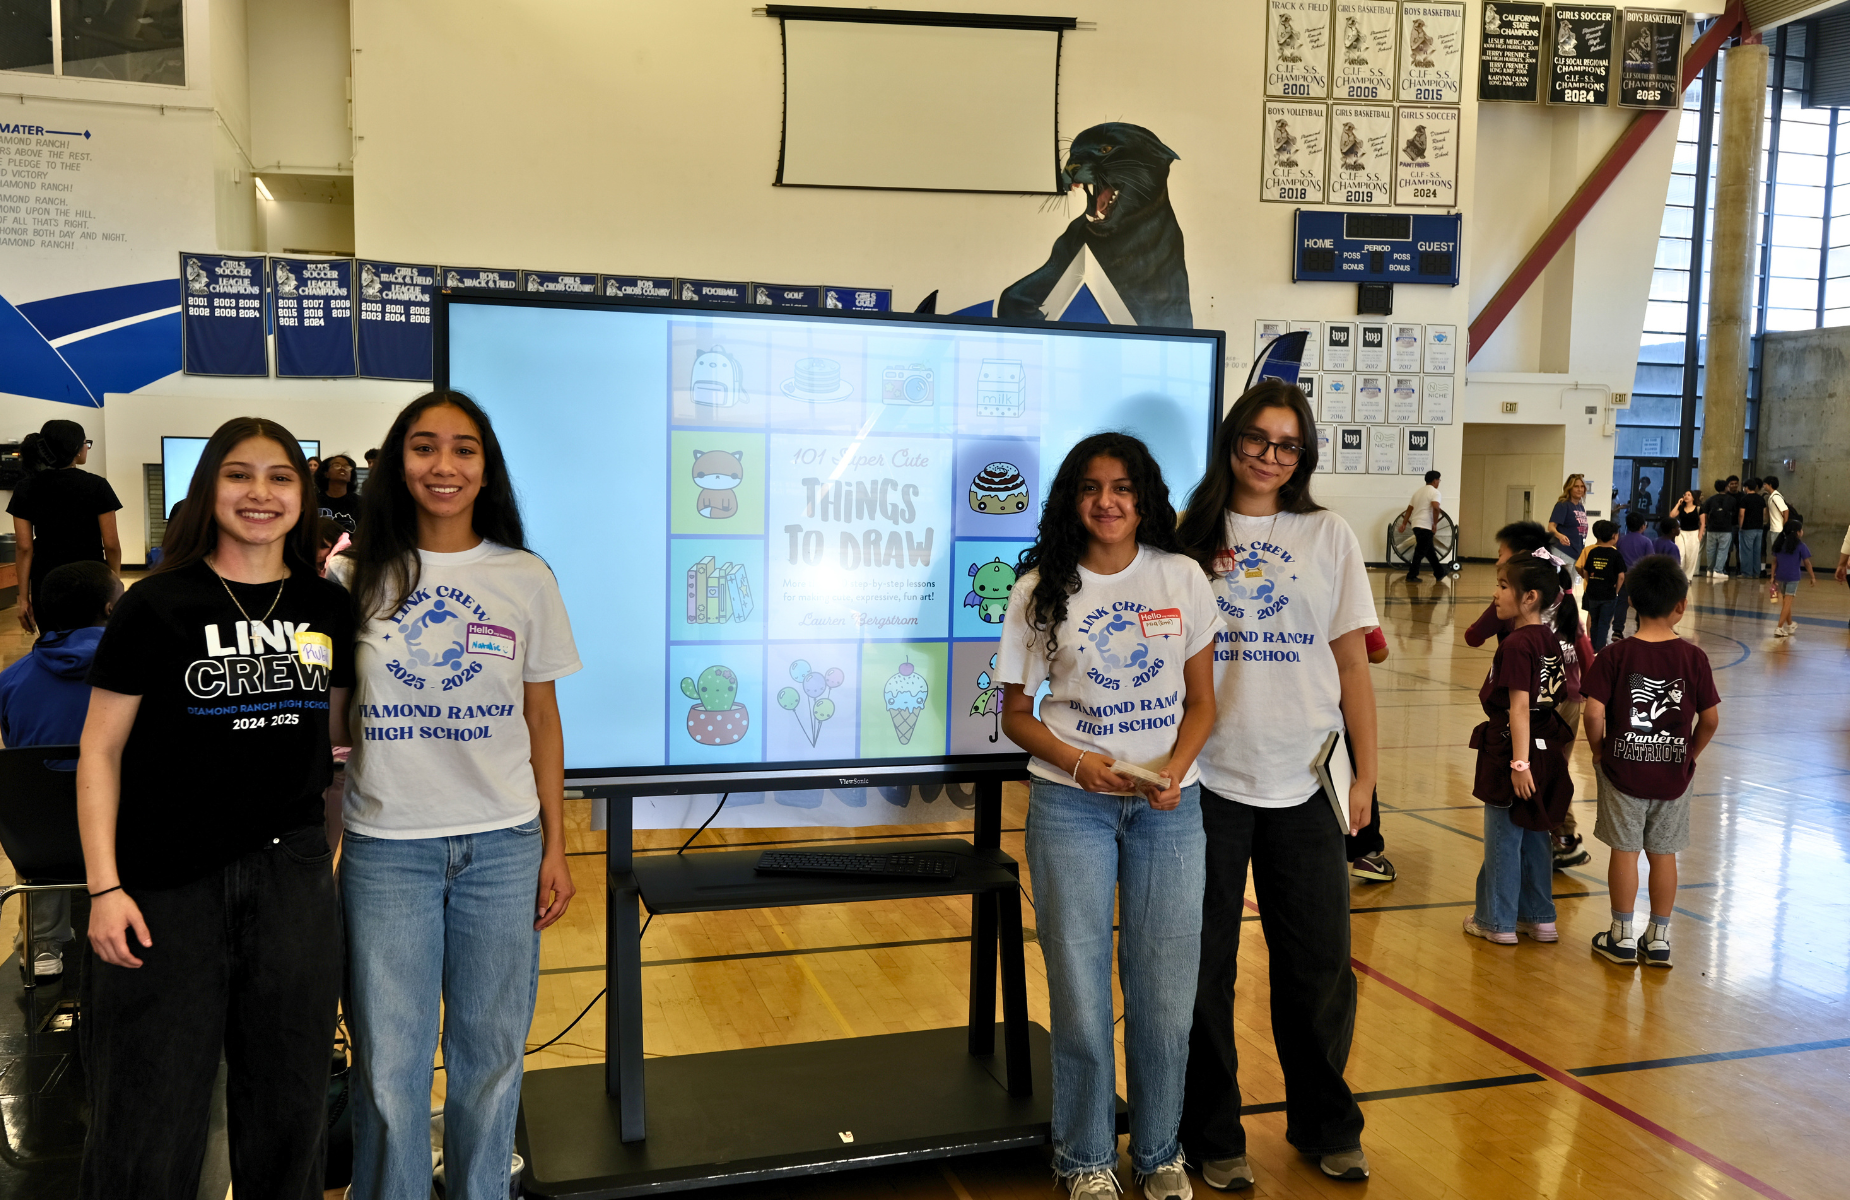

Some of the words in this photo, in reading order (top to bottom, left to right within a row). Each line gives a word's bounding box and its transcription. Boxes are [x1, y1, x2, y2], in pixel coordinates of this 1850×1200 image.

[1272, 1, 1296, 10] TRACK
[1308, 3, 1328, 12] FIELD
[1338, 4, 1356, 12] GIRLS
[1358, 6, 1394, 14] BASKETBALL
[1404, 8, 1420, 16] BOYS
[1423, 8, 1461, 18] BASKETBALL
[1502, 14, 1540, 22] CALIFORNIA
[1556, 10, 1579, 20] GIRLS
[1580, 12, 1612, 21] SOCCER
[1627, 12, 1643, 22] BOYS
[1644, 14, 1682, 24] BASKETBALL
[1501, 28, 1539, 36] CHAMPIONS
[1556, 65, 1606, 76] CHAMPIONS
[1269, 73, 1326, 88] CHAMPIONS
[1336, 76, 1392, 90] CHAMPIONS
[1402, 78, 1458, 93] CHAMPIONS
[1623, 80, 1675, 92] CHAMPIONS
[1283, 83, 1310, 96] 2001
[1348, 86, 1378, 98] 2006
[1556, 81, 1604, 92] CHAMPIONS
[1416, 88, 1442, 100] 2015
[1564, 90, 1594, 102] 2024
[1636, 90, 1661, 100] 2025
[1268, 107, 1284, 116] BOYS
[1287, 108, 1324, 117] VOLLEYBALL
[1354, 110, 1390, 118] BASKETBALL
[1401, 111, 1424, 119] GIRLS
[1426, 112, 1456, 120] SOCCER
[0, 123, 44, 136] MATER
[36, 139, 70, 149] RANCH!
[14, 148, 43, 158] ABOVE
[48, 150, 64, 159] THE
[8, 158, 41, 168] PLEDGE
[46, 161, 56, 170] TO
[60, 162, 81, 171] THEE
[12, 169, 48, 180] VICTORY
[41, 182, 73, 192] RANCH!
[1266, 178, 1322, 192] CHAMPIONS
[1332, 180, 1388, 194] CHAMPIONS
[1399, 178, 1452, 190] CHAMPIONS
[1280, 187, 1306, 200] 2018
[1346, 190, 1373, 202] 2019
[1414, 188, 1437, 198] 2024
[26, 207, 50, 216] UPON
[55, 208, 70, 217] THE
[12, 216, 28, 226] ALL
[0, 227, 28, 236] HONOR
[33, 228, 55, 238] BOTH
[59, 230, 75, 239] DAY
[80, 232, 97, 240] AND
[41, 240, 74, 250] RANCH!
[1304, 239, 1334, 248] HOME
[1418, 242, 1454, 252] GUEST
[221, 260, 246, 268] GIRLS
[215, 267, 252, 276] SOCCER
[303, 270, 338, 278] SOCCER
[395, 267, 418, 276] GIRLS
[219, 278, 250, 286] LEAGUE
[308, 280, 338, 288] LEAGUE
[210, 284, 260, 294] CHAMPIONS
[299, 287, 348, 296] CHAMPIONS
[392, 284, 422, 294] LEAGUE
[702, 287, 738, 296] FOOTBALL
[188, 296, 208, 306] 2001
[214, 298, 236, 306] 2003
[382, 291, 430, 302] CHAMPIONS
[784, 292, 804, 300] GOLF
[278, 299, 298, 308] 2001
[362, 302, 382, 311] 2000
[386, 304, 404, 313] 2001
[410, 306, 430, 315] 2002
[189, 307, 210, 316] 2002
[239, 309, 260, 318] 2024
[278, 308, 298, 316] 2015
[362, 312, 382, 320] 2003
[385, 313, 406, 322] 2004
[279, 318, 298, 326] 2021
[304, 318, 324, 326] 2024
[983, 392, 1012, 405] milk
[1615, 394, 1626, 402] EXIT
[1506, 402, 1518, 412] EXIT
[794, 448, 826, 465] 101
[892, 448, 930, 468] Cute
[1638, 498, 1648, 510] 12
[784, 524, 824, 566] TO
[840, 527, 934, 571] DRAW
[1250, 541, 1296, 564] CREW
[850, 579, 904, 590] step-by-step
[906, 578, 936, 588] lessons
[783, 591, 796, 601] for
[856, 591, 900, 604] expressive,
[904, 591, 918, 601] fun
[920, 591, 934, 601] art!
[390, 588, 432, 624] LINK
[436, 586, 490, 622] CREW
[1216, 596, 1245, 618] 2025
[1257, 594, 1290, 620] 2026
[798, 612, 846, 626] Lauren
[851, 612, 918, 630] Bergstrom
[1078, 606, 1110, 634] LINK
[1112, 601, 1154, 614] CRE
[470, 625, 494, 634] Hello
[1262, 632, 1314, 644] RANCH
[1214, 650, 1239, 662] IGH
[1242, 650, 1301, 662] SCHOOL
[185, 654, 330, 698] CREW
[386, 660, 426, 690] 2025
[442, 660, 482, 692] 2026
[1087, 668, 1120, 690] 2025
[1132, 658, 1164, 688] 2026
[188, 701, 238, 715] DIAMOND
[240, 702, 277, 712] RANCH
[279, 700, 302, 709] HIGH
[447, 704, 514, 720] RANCH
[270, 714, 300, 726] 2025
[1076, 720, 1114, 736] HIGH
[1118, 714, 1176, 733] SCHOOL
[365, 726, 414, 740] HIGH
[419, 726, 492, 742] SCHOOL
[1624, 732, 1684, 744] Pantera
